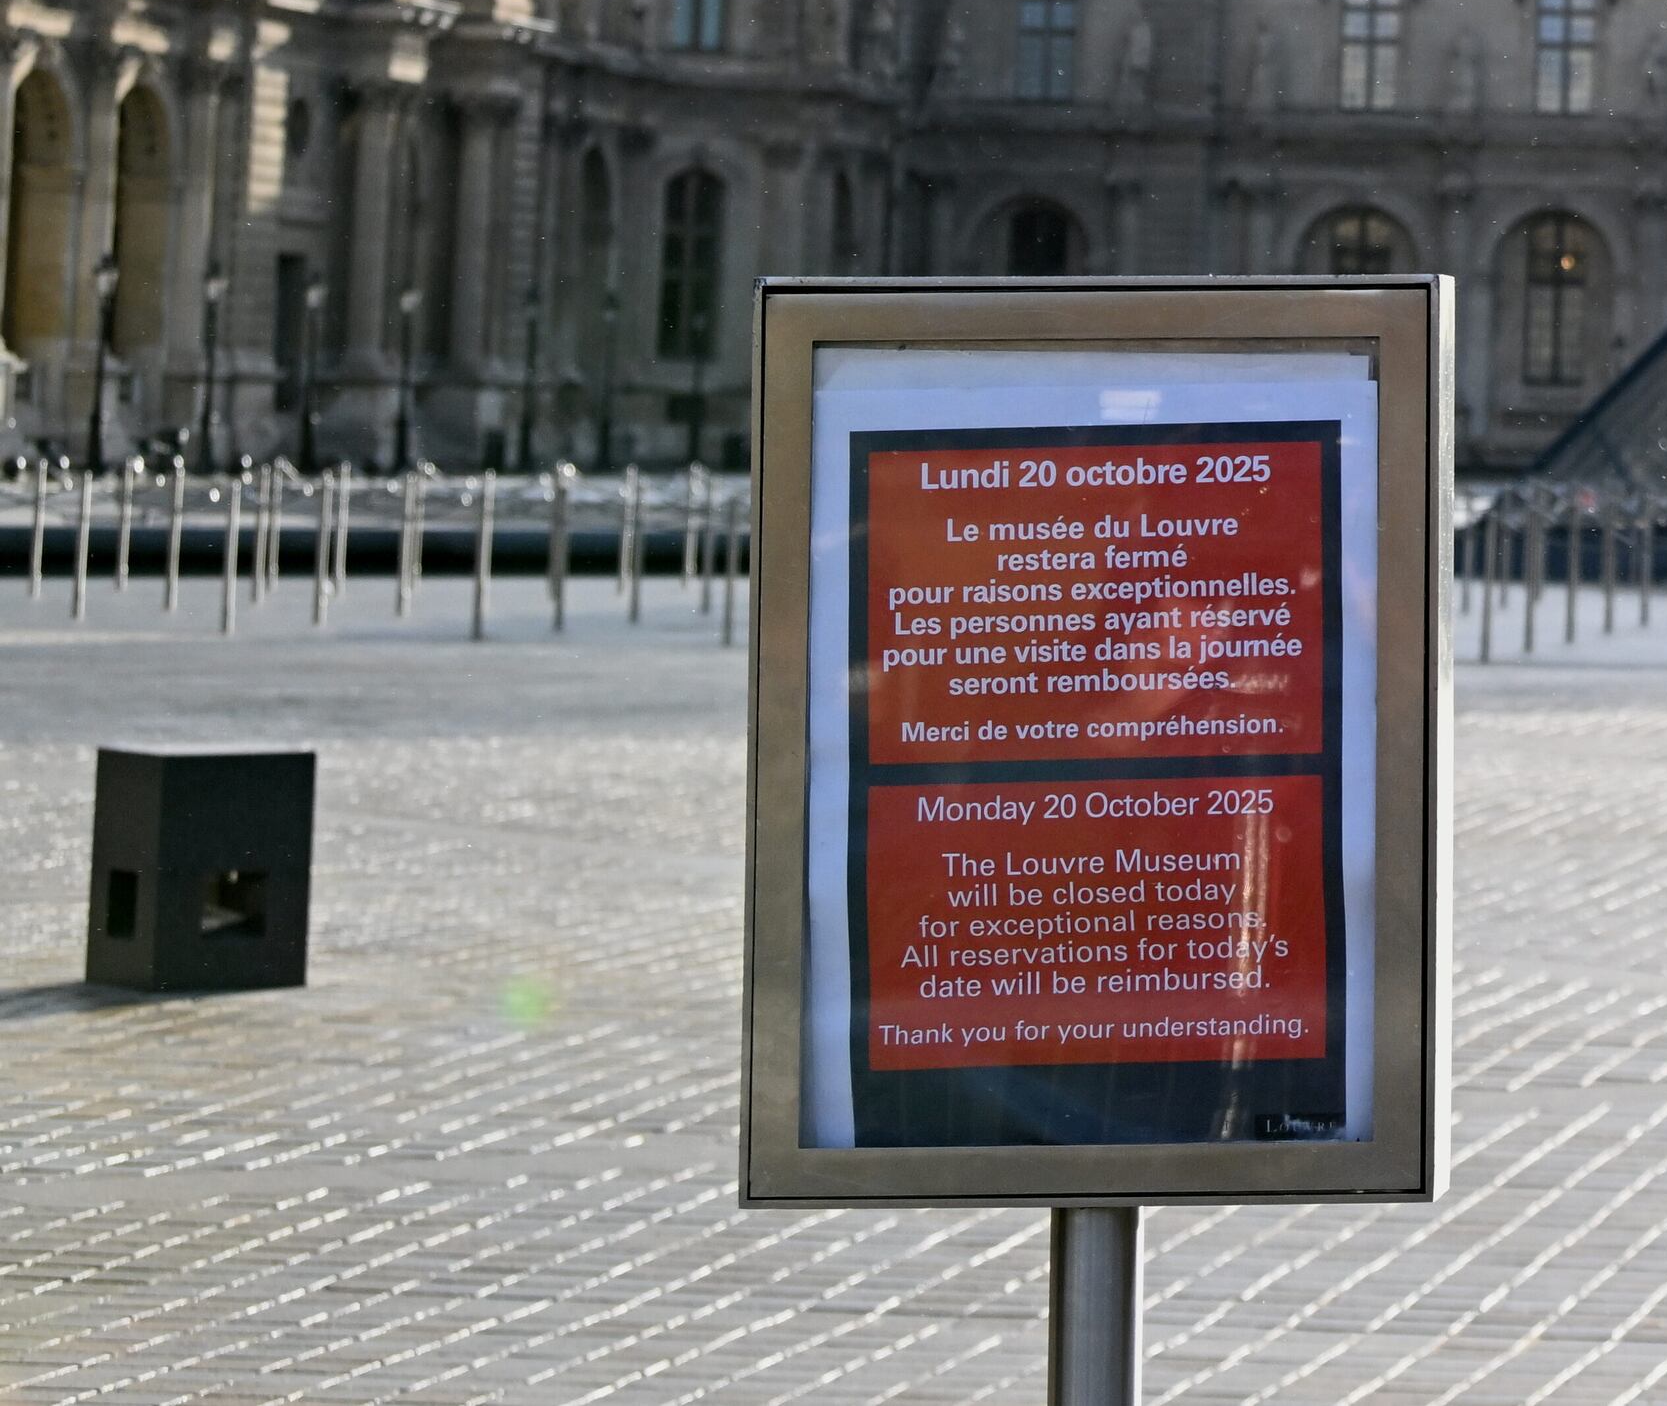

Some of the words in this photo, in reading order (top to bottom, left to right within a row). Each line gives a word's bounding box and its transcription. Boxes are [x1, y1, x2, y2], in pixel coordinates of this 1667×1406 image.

[921, 460, 1010, 491] Lundi
[1018, 459, 1057, 488] 20
[1065, 456, 1188, 487] octobre
[1195, 454, 1272, 484] 2025
[946, 518, 980, 543] Le
[989, 515, 1085, 541] musée
[1093, 514, 1130, 540] du
[1140, 512, 1239, 538] Louvre
[997, 548, 1096, 572] restera
[1104, 542, 1188, 570] fermé
[888, 585, 955, 609] pour
[962, 577, 1063, 605] raisons
[1070, 571, 1297, 604] exceptionnelles.
[895, 609, 942, 635] Les
[950, 612, 1097, 640] personnes
[1104, 604, 1182, 636] ayant
[1190, 601, 1292, 628] réservé
[882, 647, 948, 673] pour
[954, 641, 1007, 664] une
[1013, 638, 1087, 663] visite
[1094, 635, 1162, 662] dans
[1168, 635, 1194, 660] la
[1198, 633, 1303, 663] journée
[948, 672, 1039, 696] seront
[1047, 666, 1237, 694] remboursées.
[901, 720, 970, 743] Merci
[977, 719, 1008, 741] de
[1015, 720, 1080, 740] votre
[1086, 713, 1284, 742] compréhension.
[917, 794, 1036, 825] Monday
[1042, 792, 1077, 820] 20
[1085, 790, 1200, 819] October
[1206, 788, 1274, 819] 2025
[941, 852, 996, 878] The
[1006, 851, 1105, 876] Louvre
[1115, 847, 1242, 873] Museum
[947, 882, 997, 908] will
[1009, 882, 1043, 907] be
[1052, 879, 1145, 905] closed
[1154, 875, 1237, 907] today
[918, 914, 960, 939] for
[969, 909, 1136, 941] exceptional
[1146, 908, 1269, 934] reasons.
[900, 944, 938, 969] All
[950, 939, 1128, 966] reservations
[1136, 937, 1179, 962] for
[1186, 933, 1289, 964] today's
[919, 974, 982, 999] date
[990, 970, 1041, 996] will
[1052, 970, 1086, 995] be
[1097, 966, 1270, 994] reimbursed.
[878, 1022, 953, 1046] Thank
[961, 1025, 1006, 1048] you
[1014, 1019, 1051, 1041] for
[1057, 1023, 1115, 1045] your
[1122, 1013, 1309, 1044] understanding.
